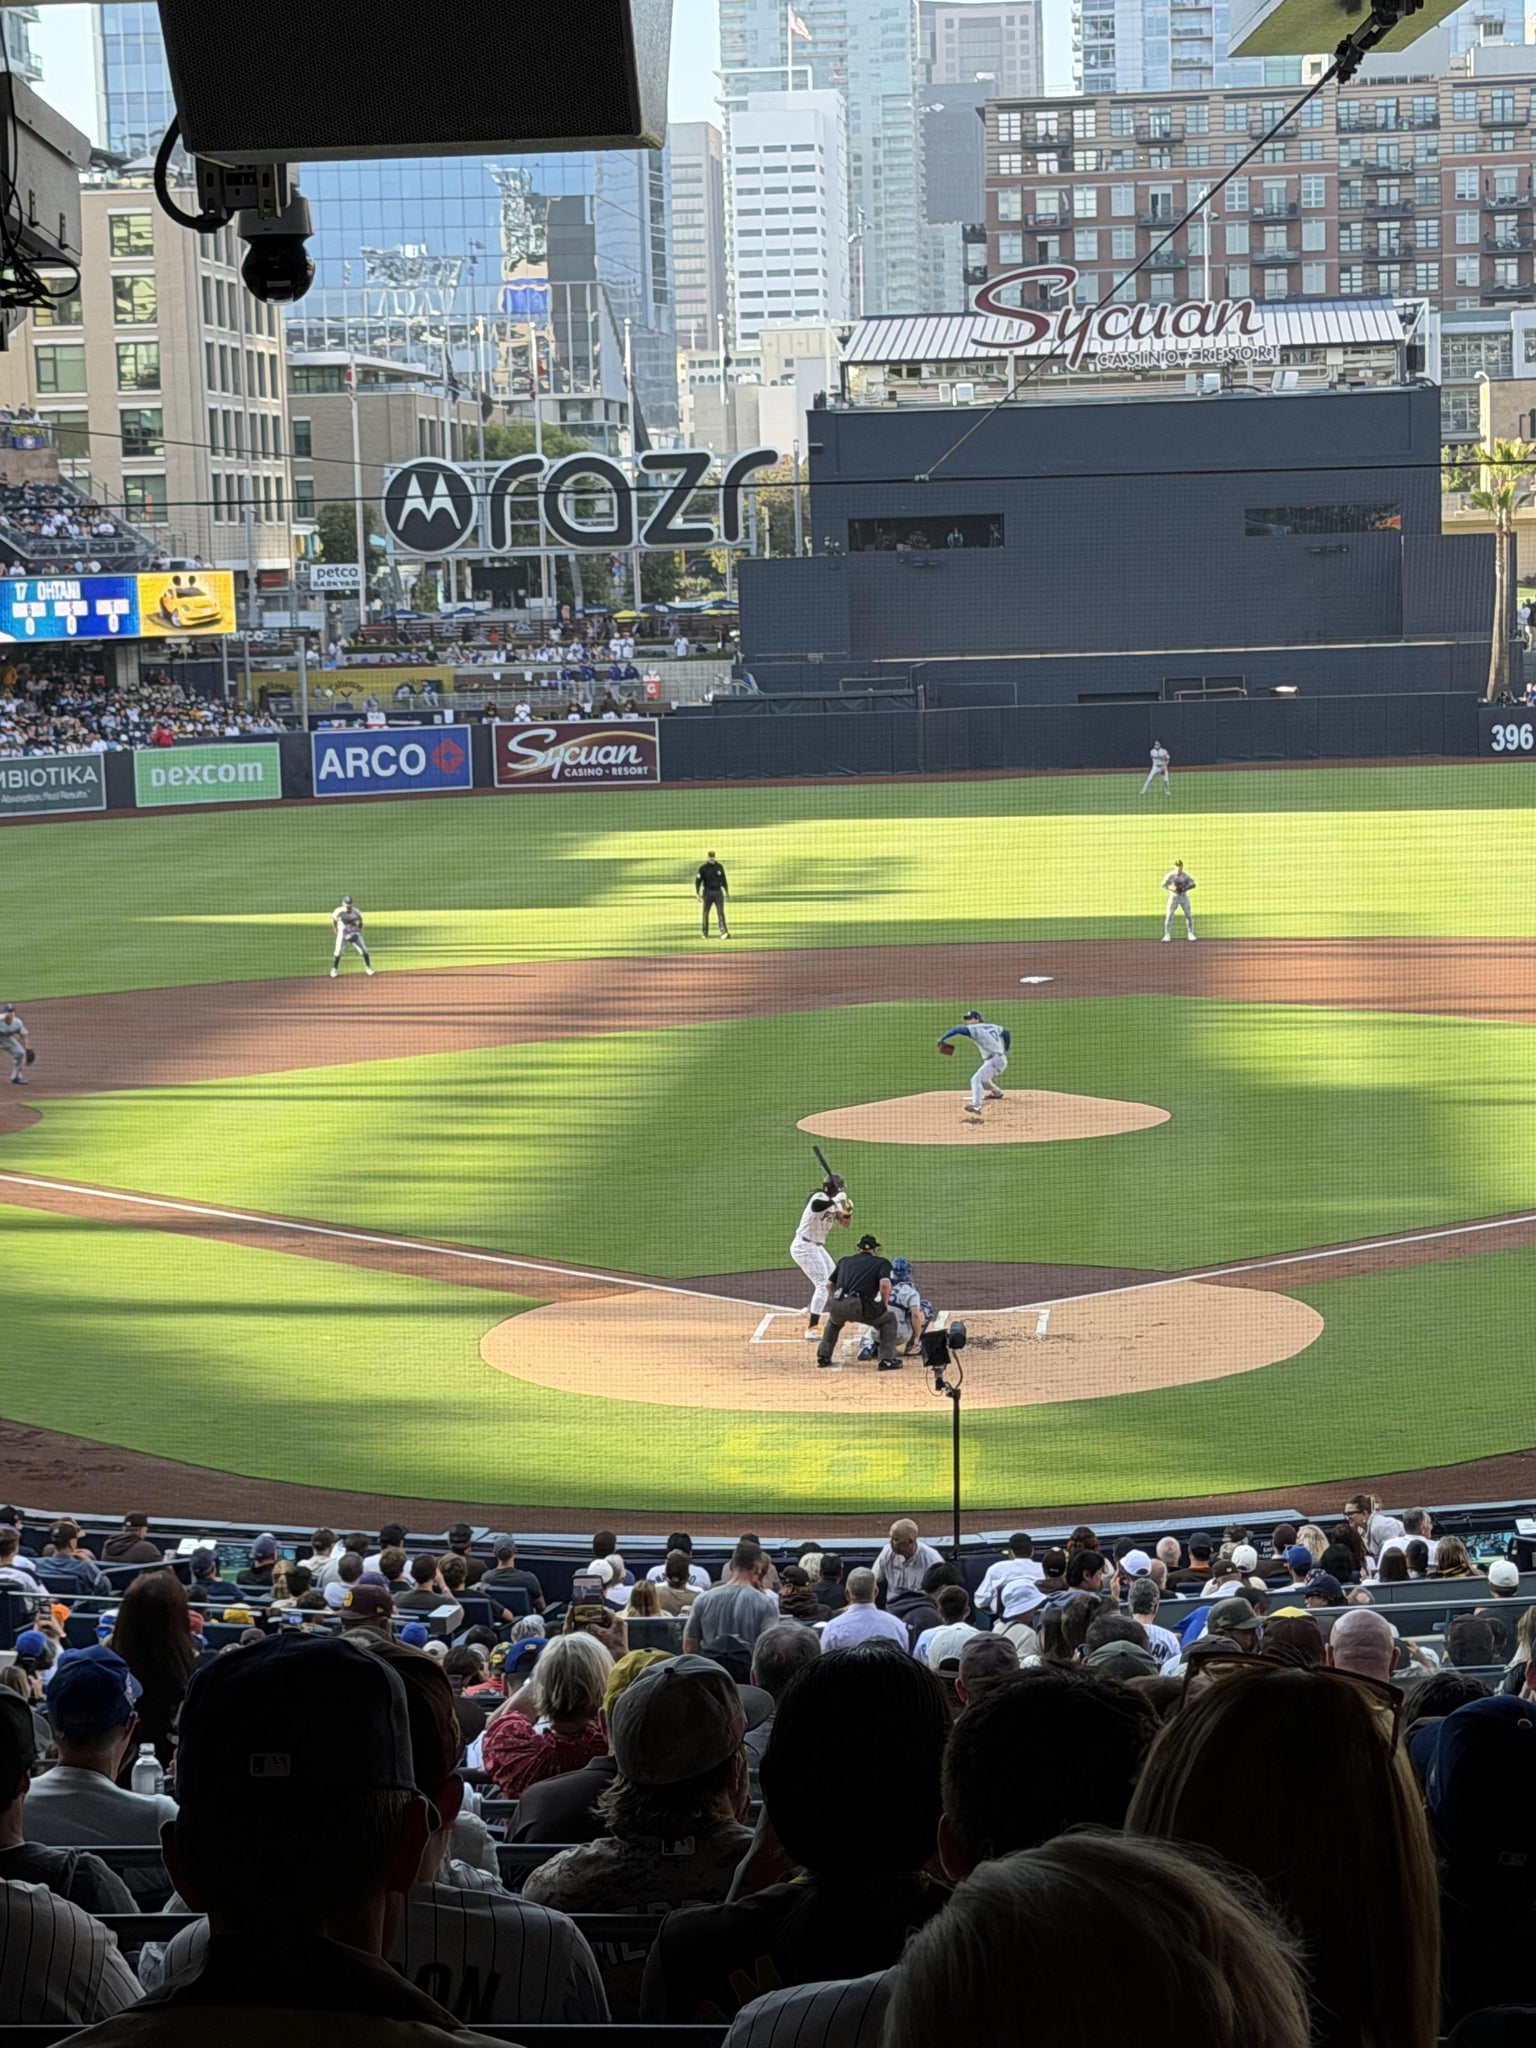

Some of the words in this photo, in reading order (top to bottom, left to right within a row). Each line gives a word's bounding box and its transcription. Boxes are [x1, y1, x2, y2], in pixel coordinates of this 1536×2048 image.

[970, 264, 1264, 370] Sycuan
[1096, 351, 1179, 368] CASINO
[1201, 345, 1279, 363] RESORT
[488, 446, 779, 553] razr
[316, 567, 359, 580] petco
[14, 582, 28, 600] 17
[37, 581, 81, 600] OHTANI
[1491, 723, 1534, 751] 396
[318, 743, 427, 780] ARCO
[507, 728, 643, 780] Sycuan
[564, 767, 603, 777] CASINO
[611, 766, 648, 775] RESORT
